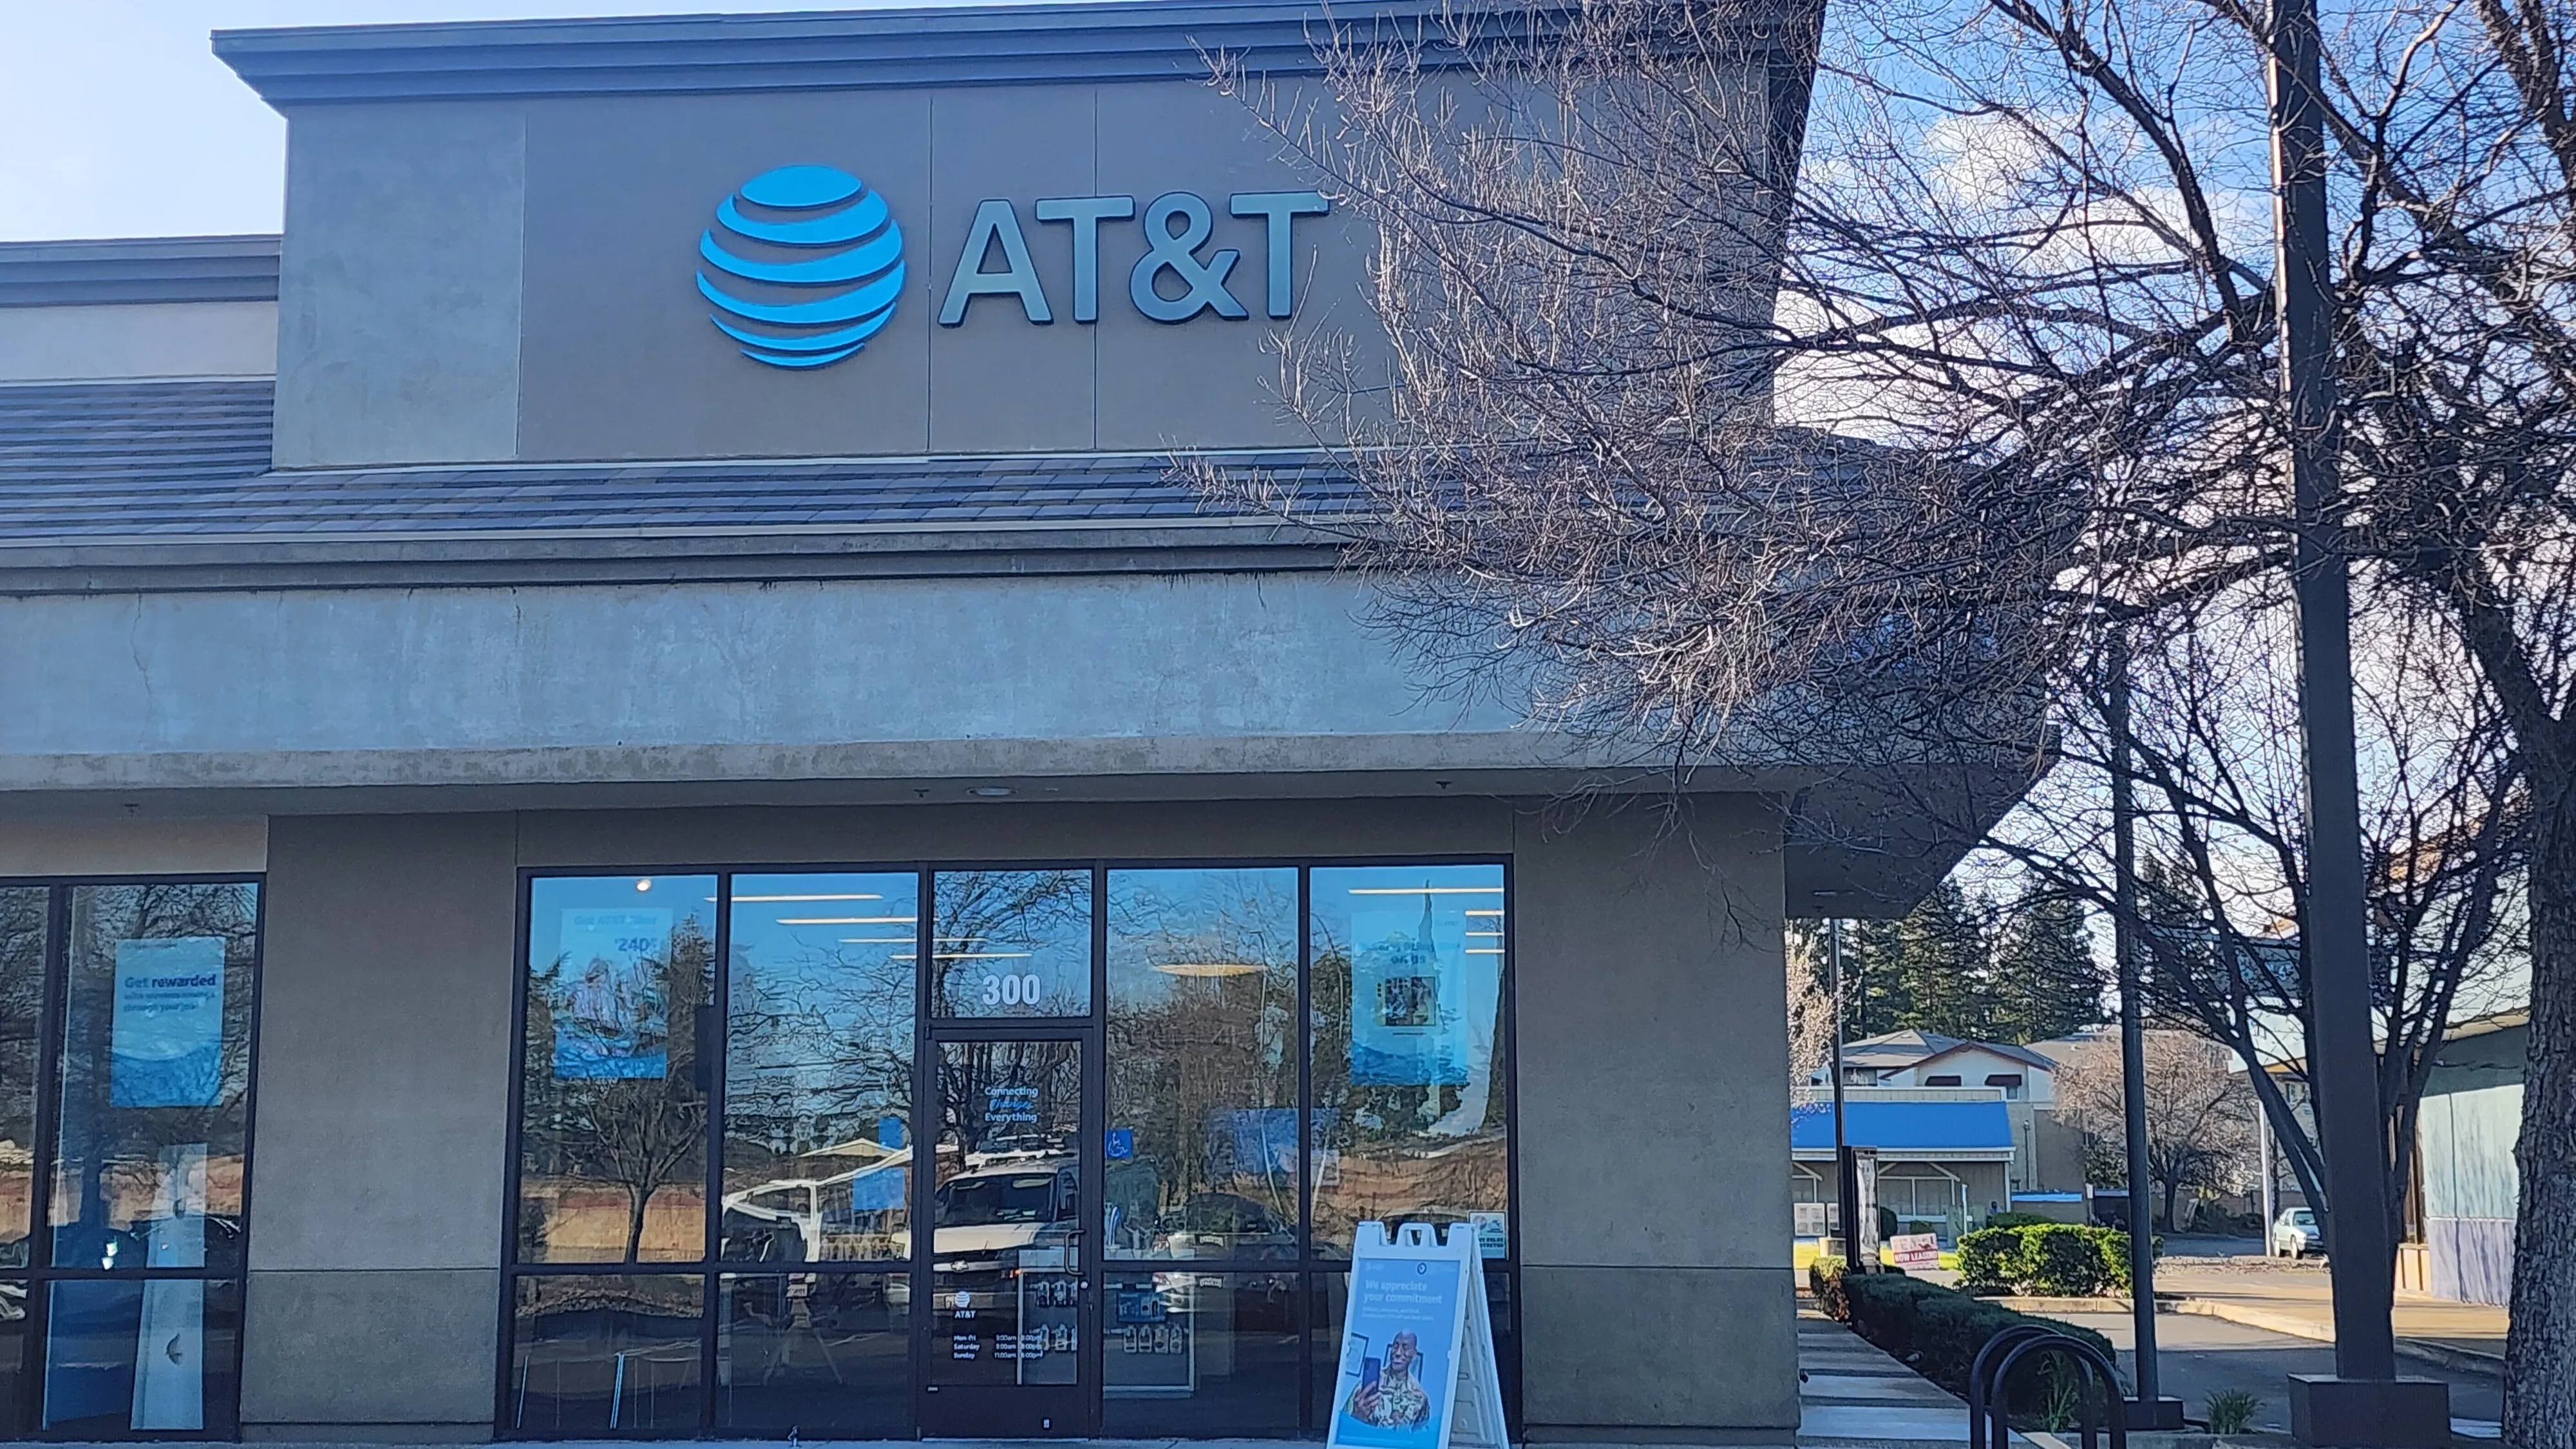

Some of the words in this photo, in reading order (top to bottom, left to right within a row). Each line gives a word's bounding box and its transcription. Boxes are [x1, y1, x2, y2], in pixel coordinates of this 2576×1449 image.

[938, 191, 1331, 327] AT&T
[124, 976, 149, 988] Get
[151, 974, 216, 988] rewarded
[982, 974, 1041, 1005] 300
[985, 1086, 1039, 1097] Connecting
[985, 1112, 1037, 1123] Everything
[1365, 1279, 1379, 1290] We
[1381, 1280, 1428, 1293] appreciate
[1363, 1293, 1384, 1304] your
[1385, 1292, 1443, 1304] commitment
[954, 1311, 976, 1319] AT&T
